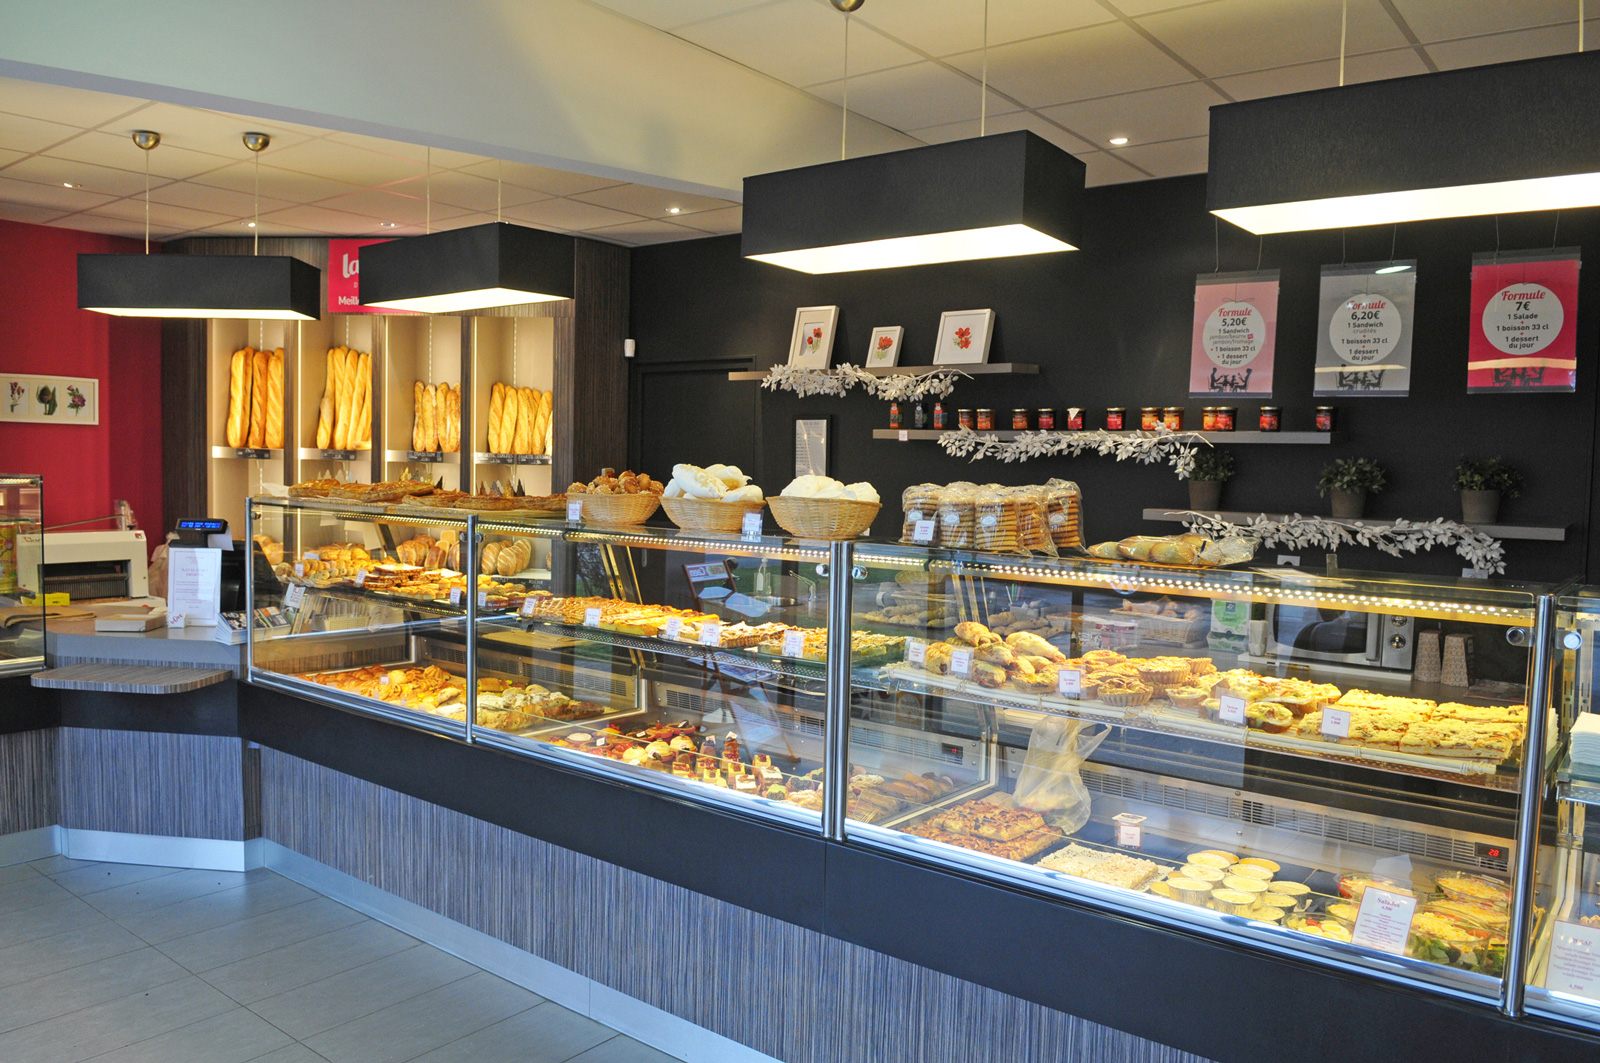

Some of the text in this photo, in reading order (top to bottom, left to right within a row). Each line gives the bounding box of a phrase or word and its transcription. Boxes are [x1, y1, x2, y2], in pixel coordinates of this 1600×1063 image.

[1502, 290, 1546, 301] Formule
[1515, 301, 1530, 311] 7€
[1218, 307, 1252, 317] Formule
[1351, 310, 1380, 321] 6,20€
[1222, 317, 1247, 327] 5,20€
[1377, 897, 1400, 908] Salades
